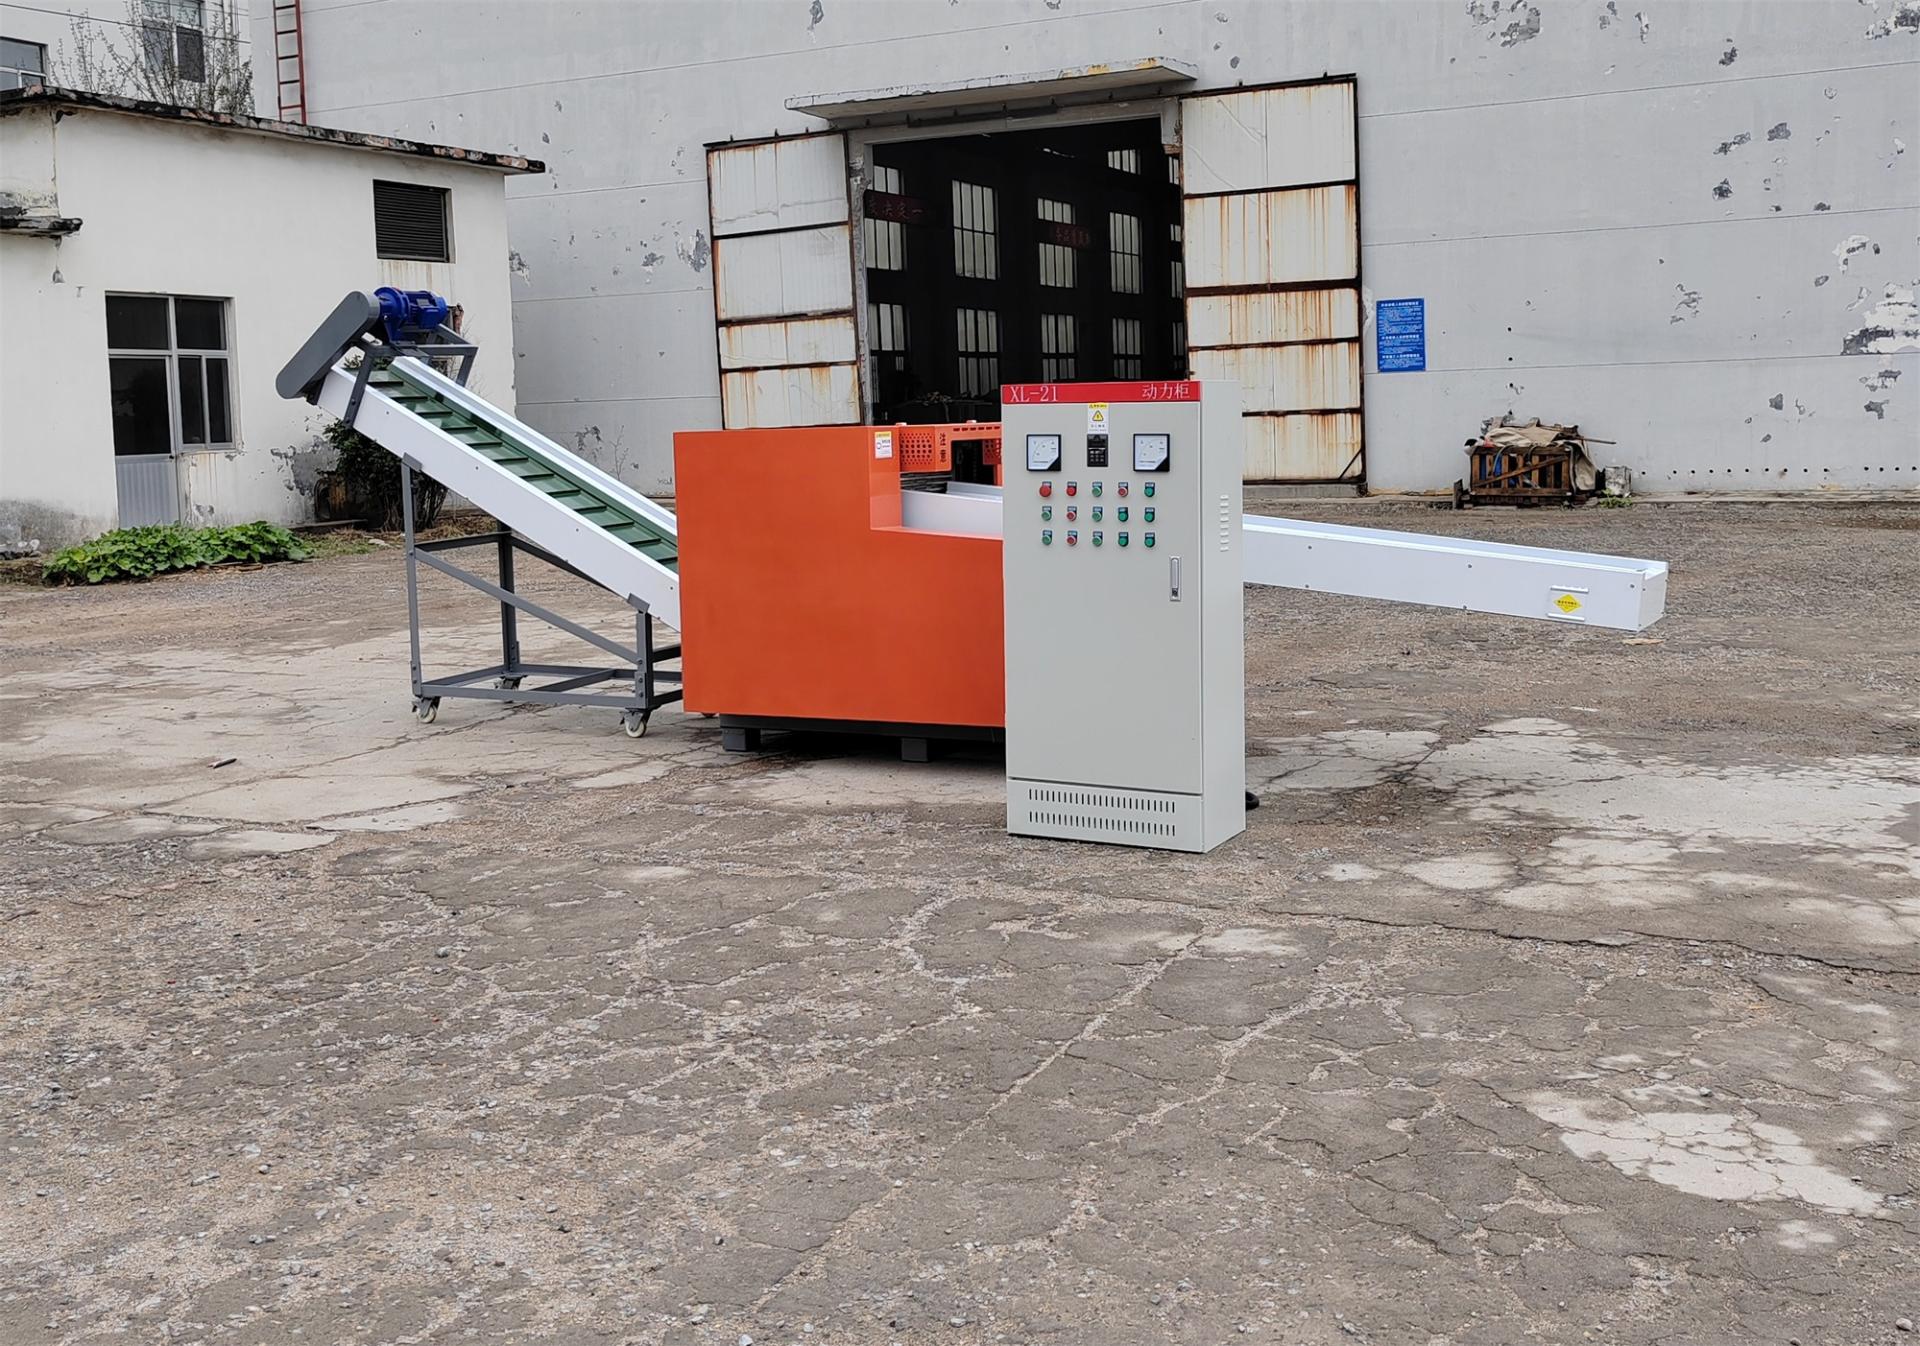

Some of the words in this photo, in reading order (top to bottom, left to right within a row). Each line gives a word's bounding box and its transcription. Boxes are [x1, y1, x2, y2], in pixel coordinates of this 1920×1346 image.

[1010, 385, 1057, 403] XL-21
[1142, 383, 1190, 399] 动力柜
